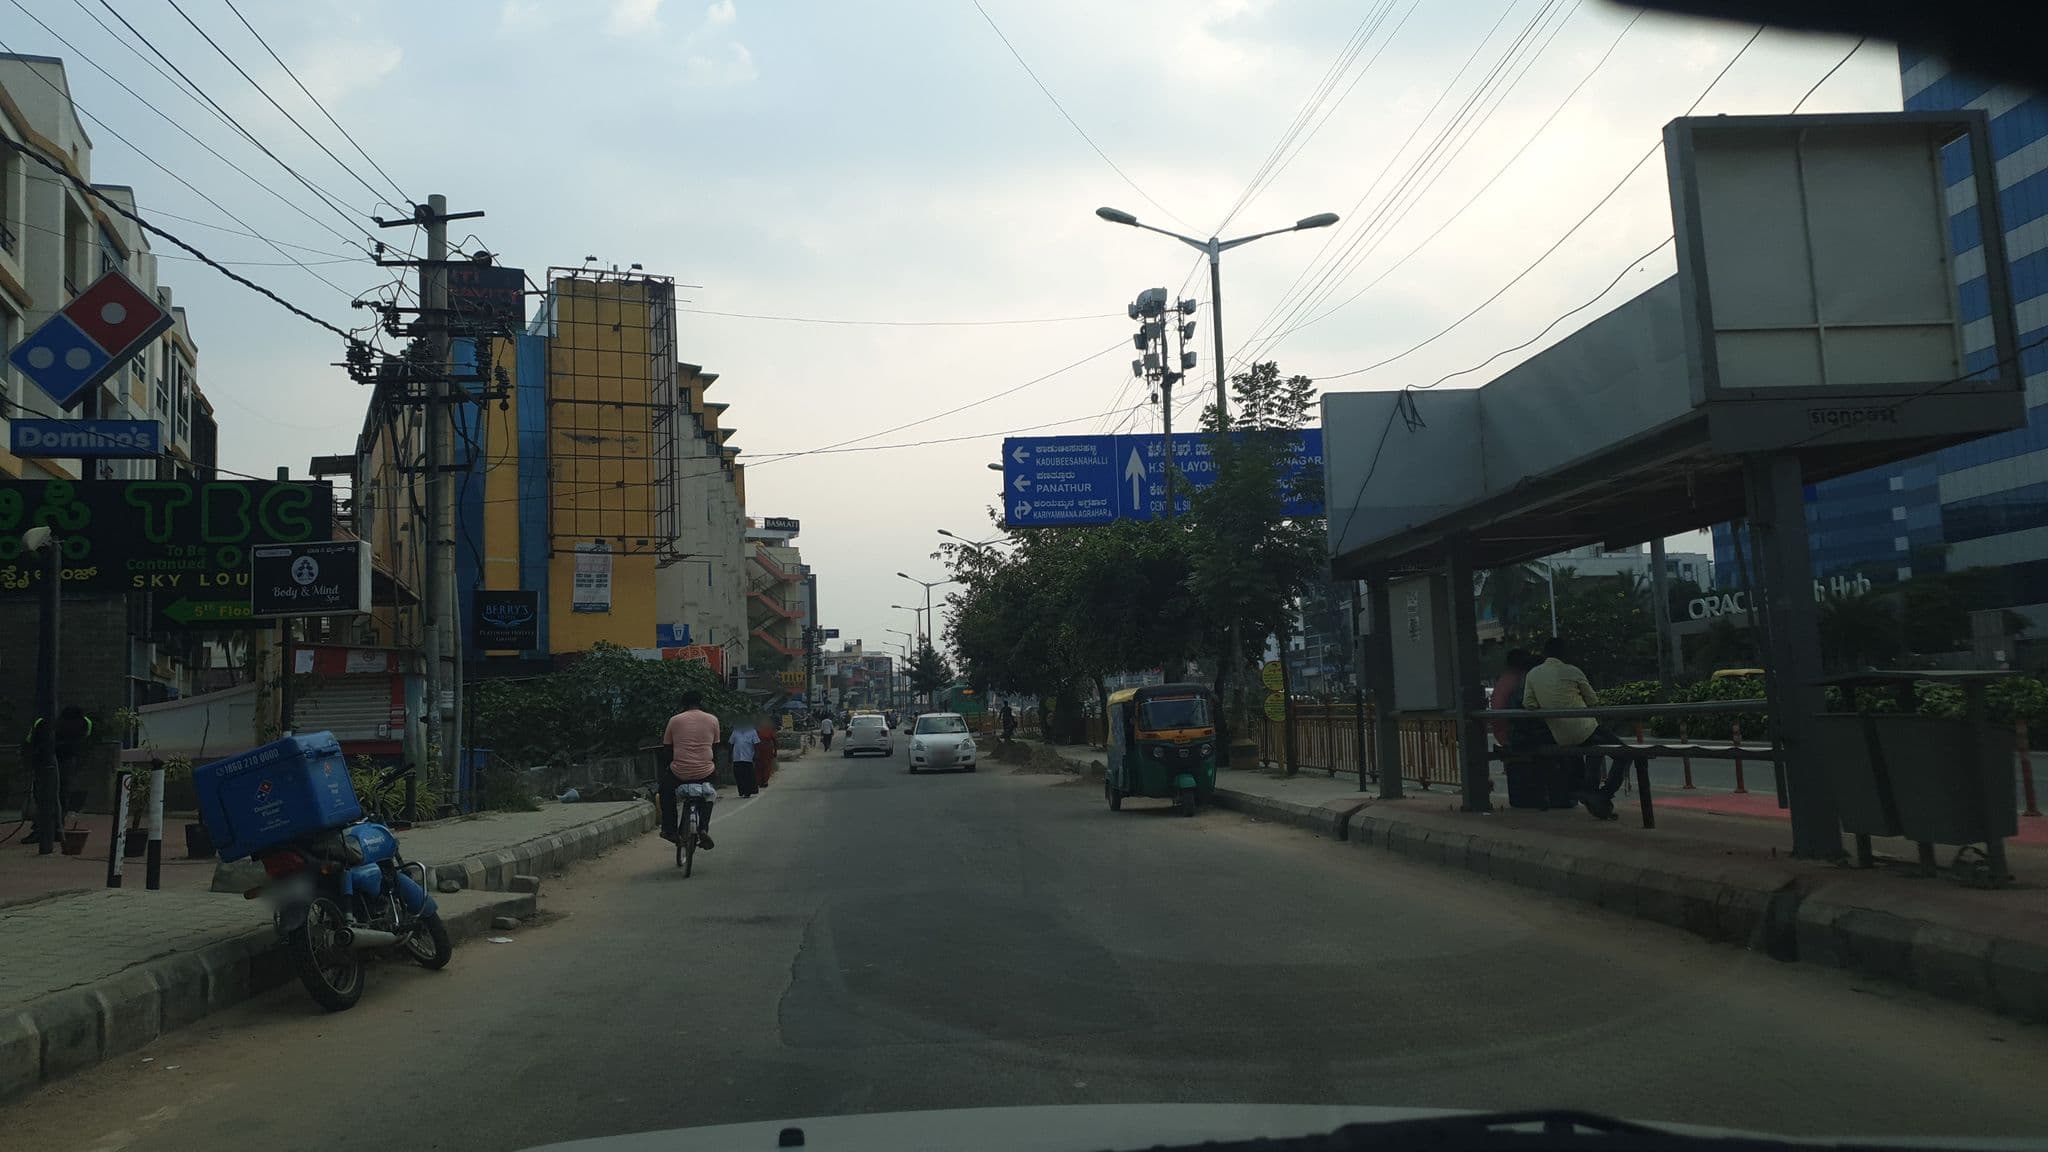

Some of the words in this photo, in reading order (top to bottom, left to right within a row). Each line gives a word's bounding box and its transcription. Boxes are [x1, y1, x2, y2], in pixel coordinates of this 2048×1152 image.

[18, 426, 151, 450] Domino's
[1035, 456, 1108, 467] KADUBEESANAHALLI
[1036, 483, 1092, 493] PANATHUR
[124, 482, 313, 544] TBC
[133, 574, 181, 588] SKY
[273, 585, 298, 599] Body
[301, 585, 311, 597] &
[312, 584, 340, 595] Mind
[220, 604, 251, 617] Floo
